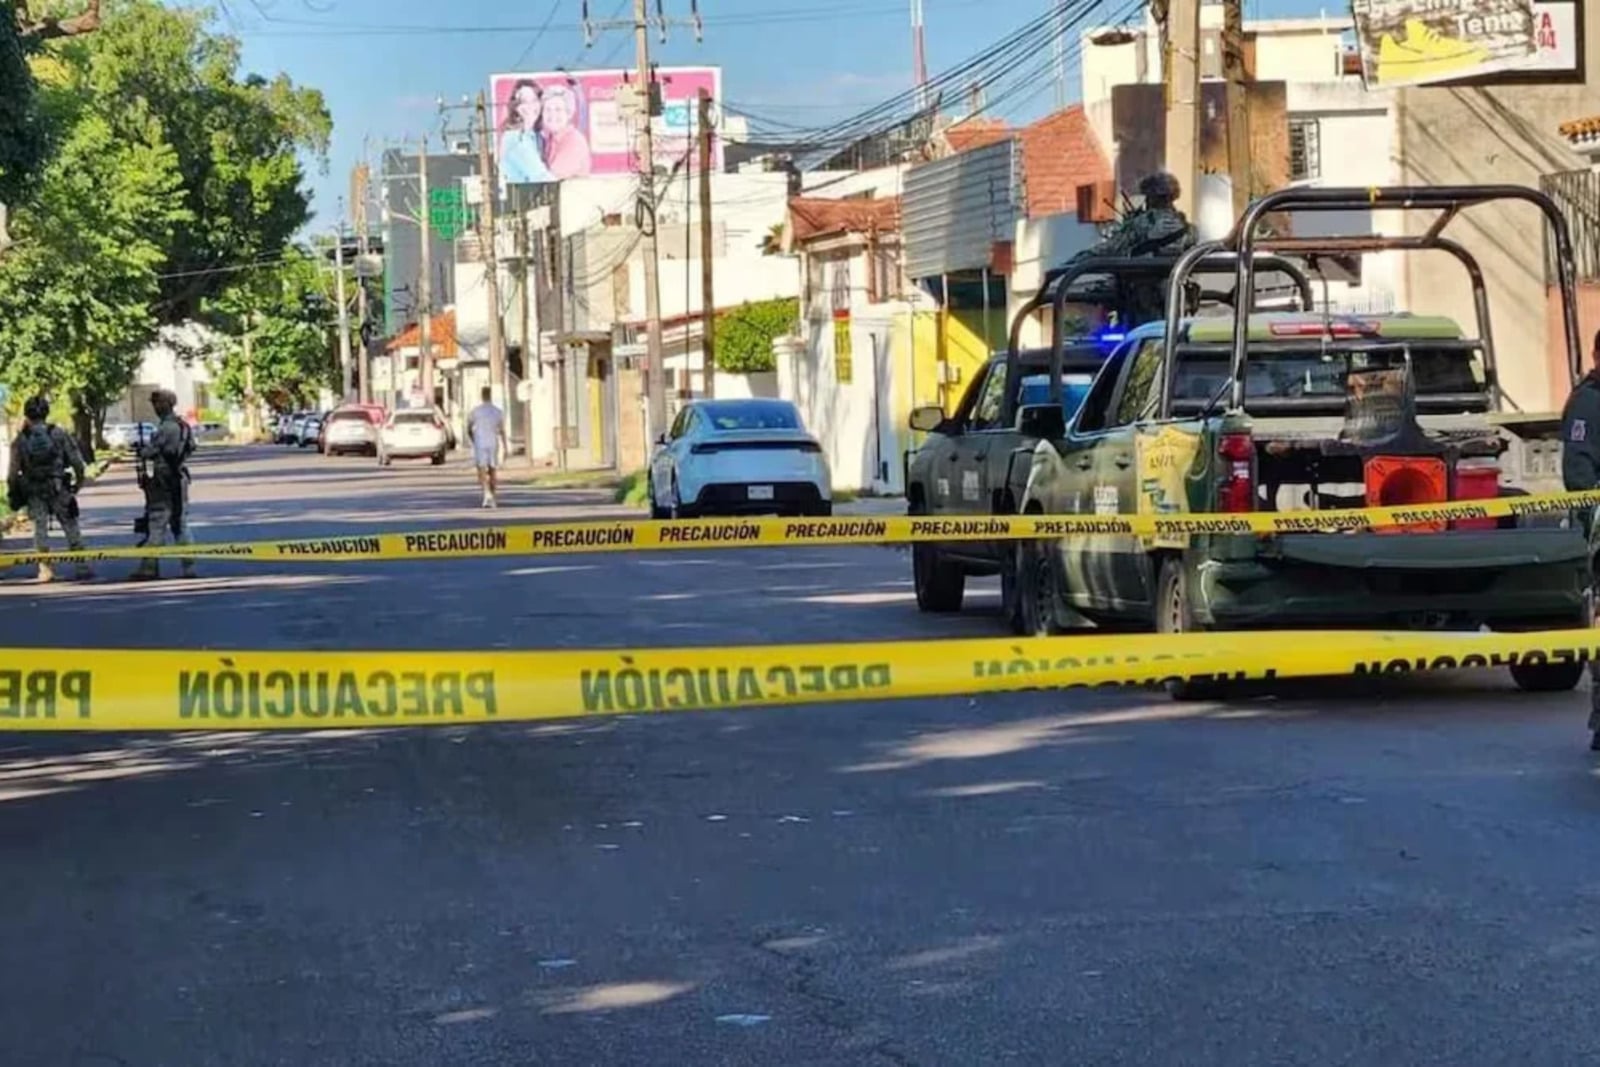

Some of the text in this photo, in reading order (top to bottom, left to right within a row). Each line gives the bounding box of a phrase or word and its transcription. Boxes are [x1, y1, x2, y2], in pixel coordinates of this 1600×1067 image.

[405, 528, 507, 552] PRECAUCIÓN
[532, 523, 634, 547] PRECAUCIÓN
[659, 520, 761, 542] PRECAUCIÓN
[785, 518, 887, 538] PRECAUCIÓN
[911, 517, 1010, 535] PRECAUCIÓN
[1034, 515, 1132, 533] PRECAUCIÓN
[1154, 515, 1252, 533] PRECAUCIÓN
[1273, 512, 1370, 530] PRECAUCIÓN
[1391, 504, 1488, 523] PRECAUCIÓN
